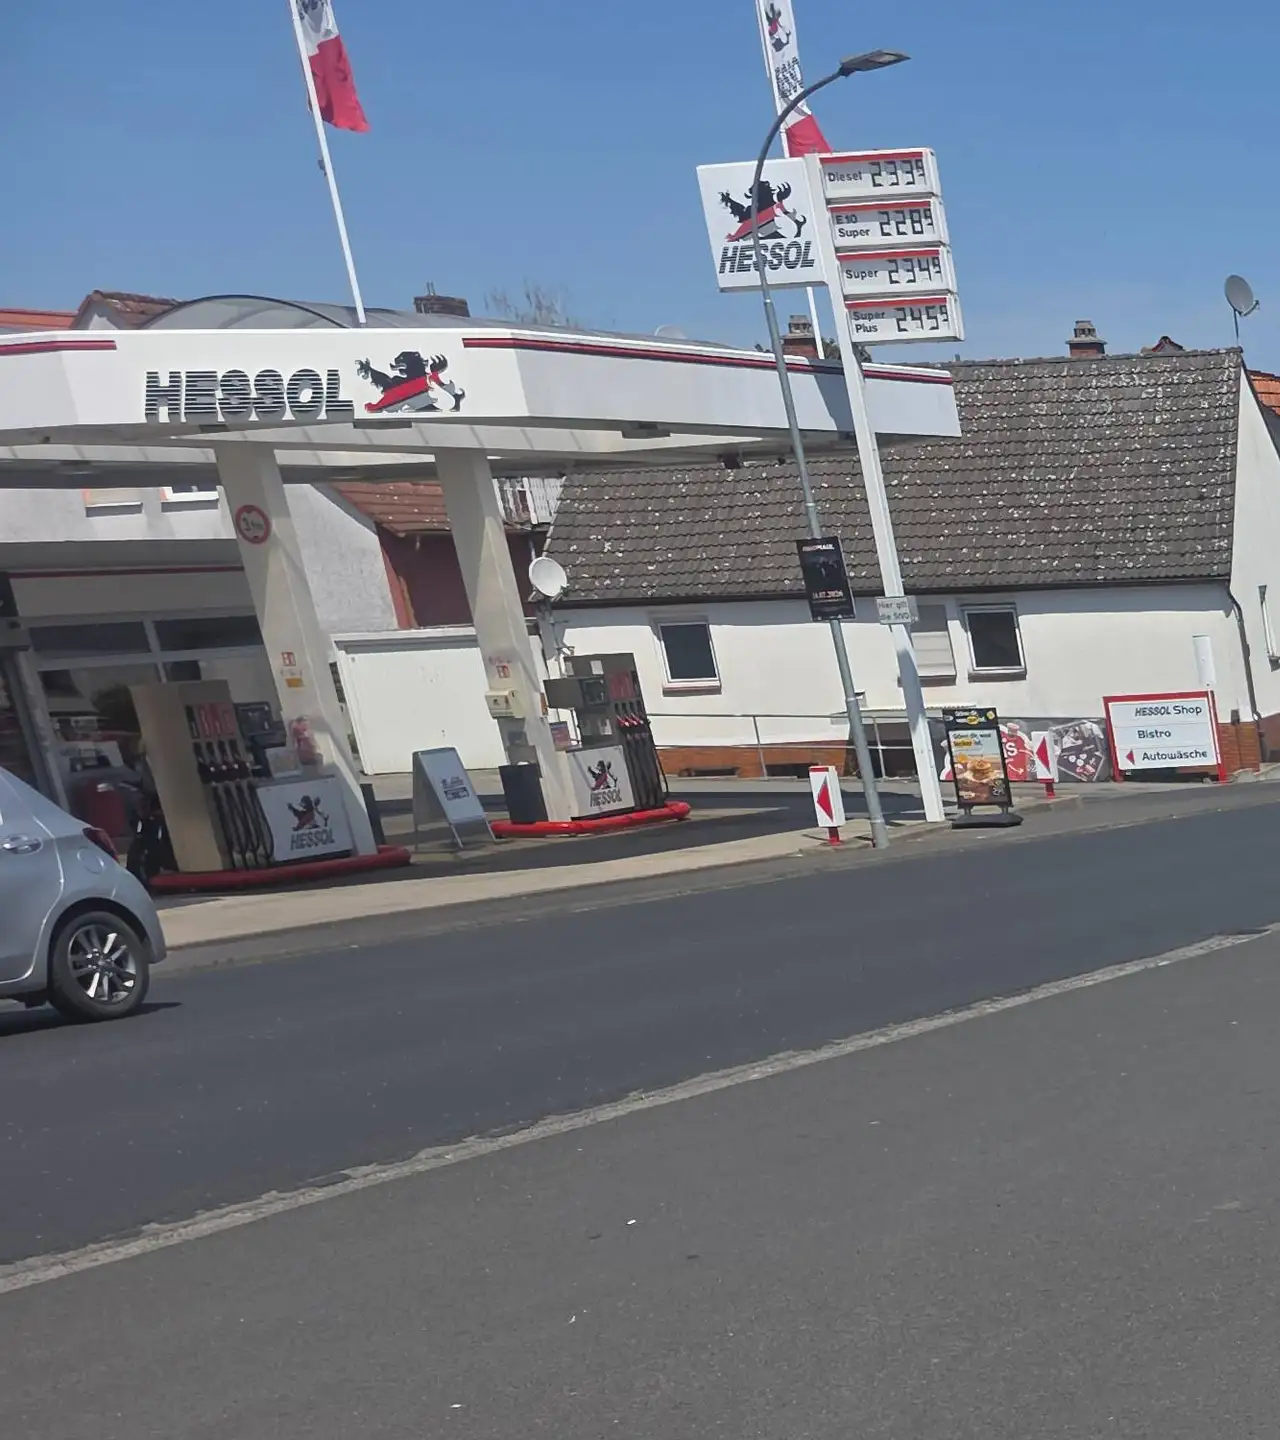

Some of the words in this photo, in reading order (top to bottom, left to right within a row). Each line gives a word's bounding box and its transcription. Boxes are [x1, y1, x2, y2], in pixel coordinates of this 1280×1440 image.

[827, 171, 862, 182] Diesel
[836, 214, 858, 225] E10
[838, 227, 871, 239] Super
[719, 240, 815, 274] HESSOL
[845, 268, 879, 281] Super
[853, 311, 886, 322] Super
[855, 323, 878, 334] Plus
[145, 369, 354, 418] HESSOL
[1135, 706, 1172, 717] HESSOL
[1172, 705, 1202, 716] Shop
[1137, 730, 1172, 739] Bistro
[1142, 749, 1208, 761] Autowäsche
[590, 788, 623, 808] HESSOL
[290, 827, 336, 851] HESSOL
